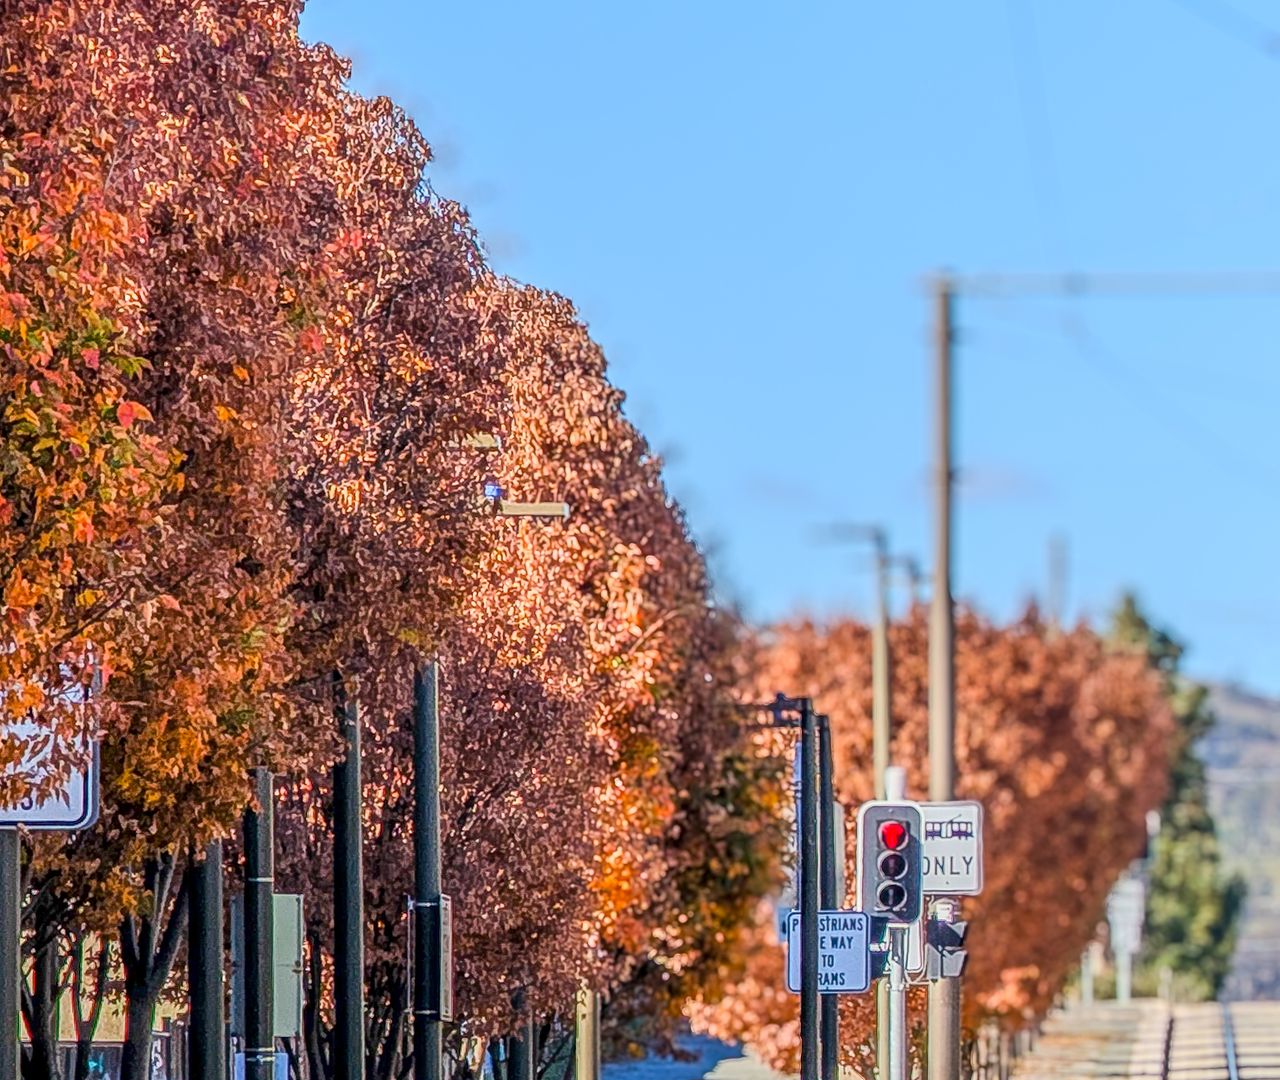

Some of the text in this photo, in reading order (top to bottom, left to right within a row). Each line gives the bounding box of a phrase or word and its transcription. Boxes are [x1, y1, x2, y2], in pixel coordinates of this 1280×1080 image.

[922, 855, 973, 876] ONLY
[792, 917, 863, 932] PSTRIANS
[831, 935, 853, 949] WAY
[821, 954, 835, 968] TO
[817, 972, 846, 986] RAMS
